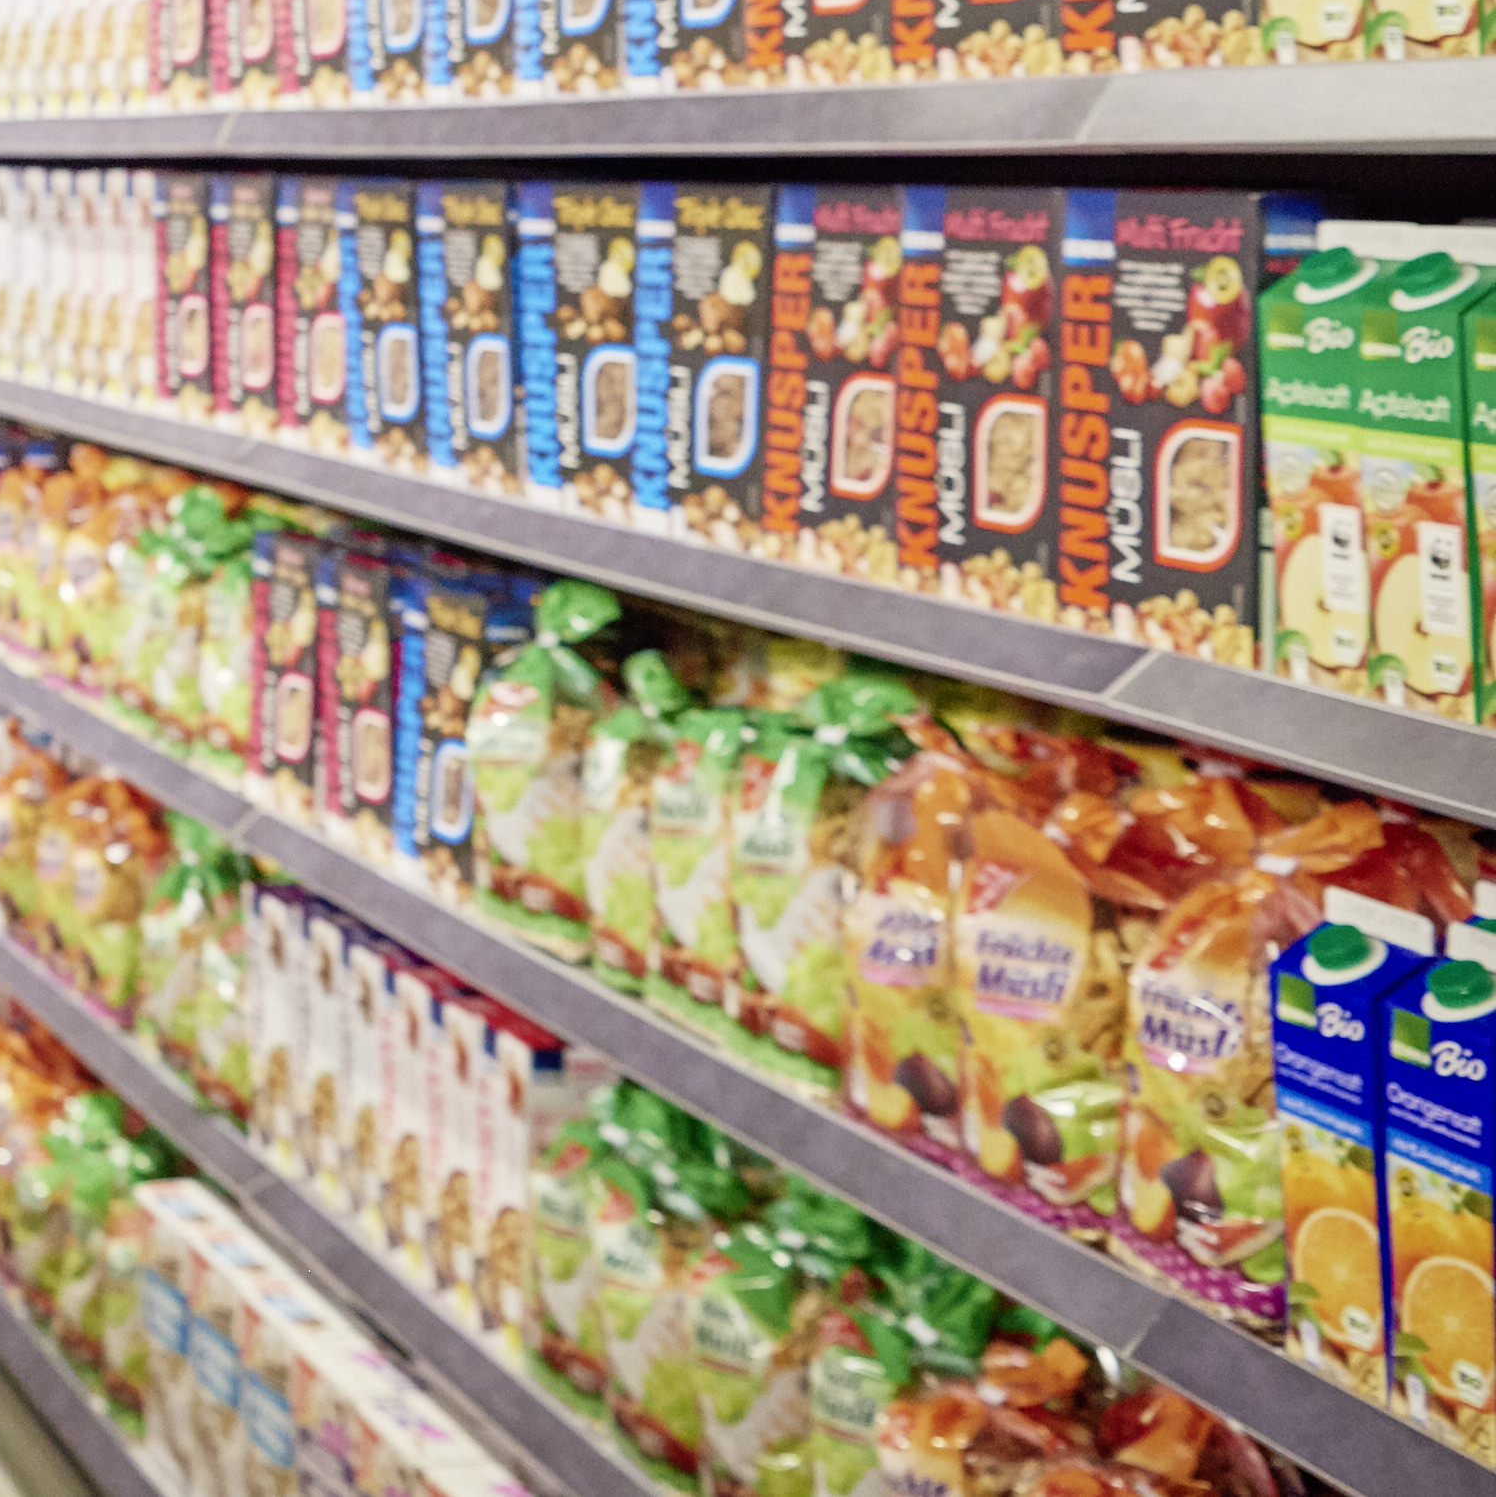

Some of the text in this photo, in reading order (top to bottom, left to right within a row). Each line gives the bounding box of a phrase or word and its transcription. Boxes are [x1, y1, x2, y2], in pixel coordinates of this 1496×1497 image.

[1305, 316, 1355, 354] Bio
[1401, 326, 1456, 364] Bio
[762, 252, 811, 534] KNUSPER
[1359, 388, 1451, 422] Apfelsaft
[896, 262, 942, 568] KNUSPER
[1059, 273, 1112, 610] KNUSPER
[1108, 427, 1143, 584] MÜSLI
[1317, 1002, 1365, 1042] Bio
[1431, 1040, 1488, 1082] Bio
